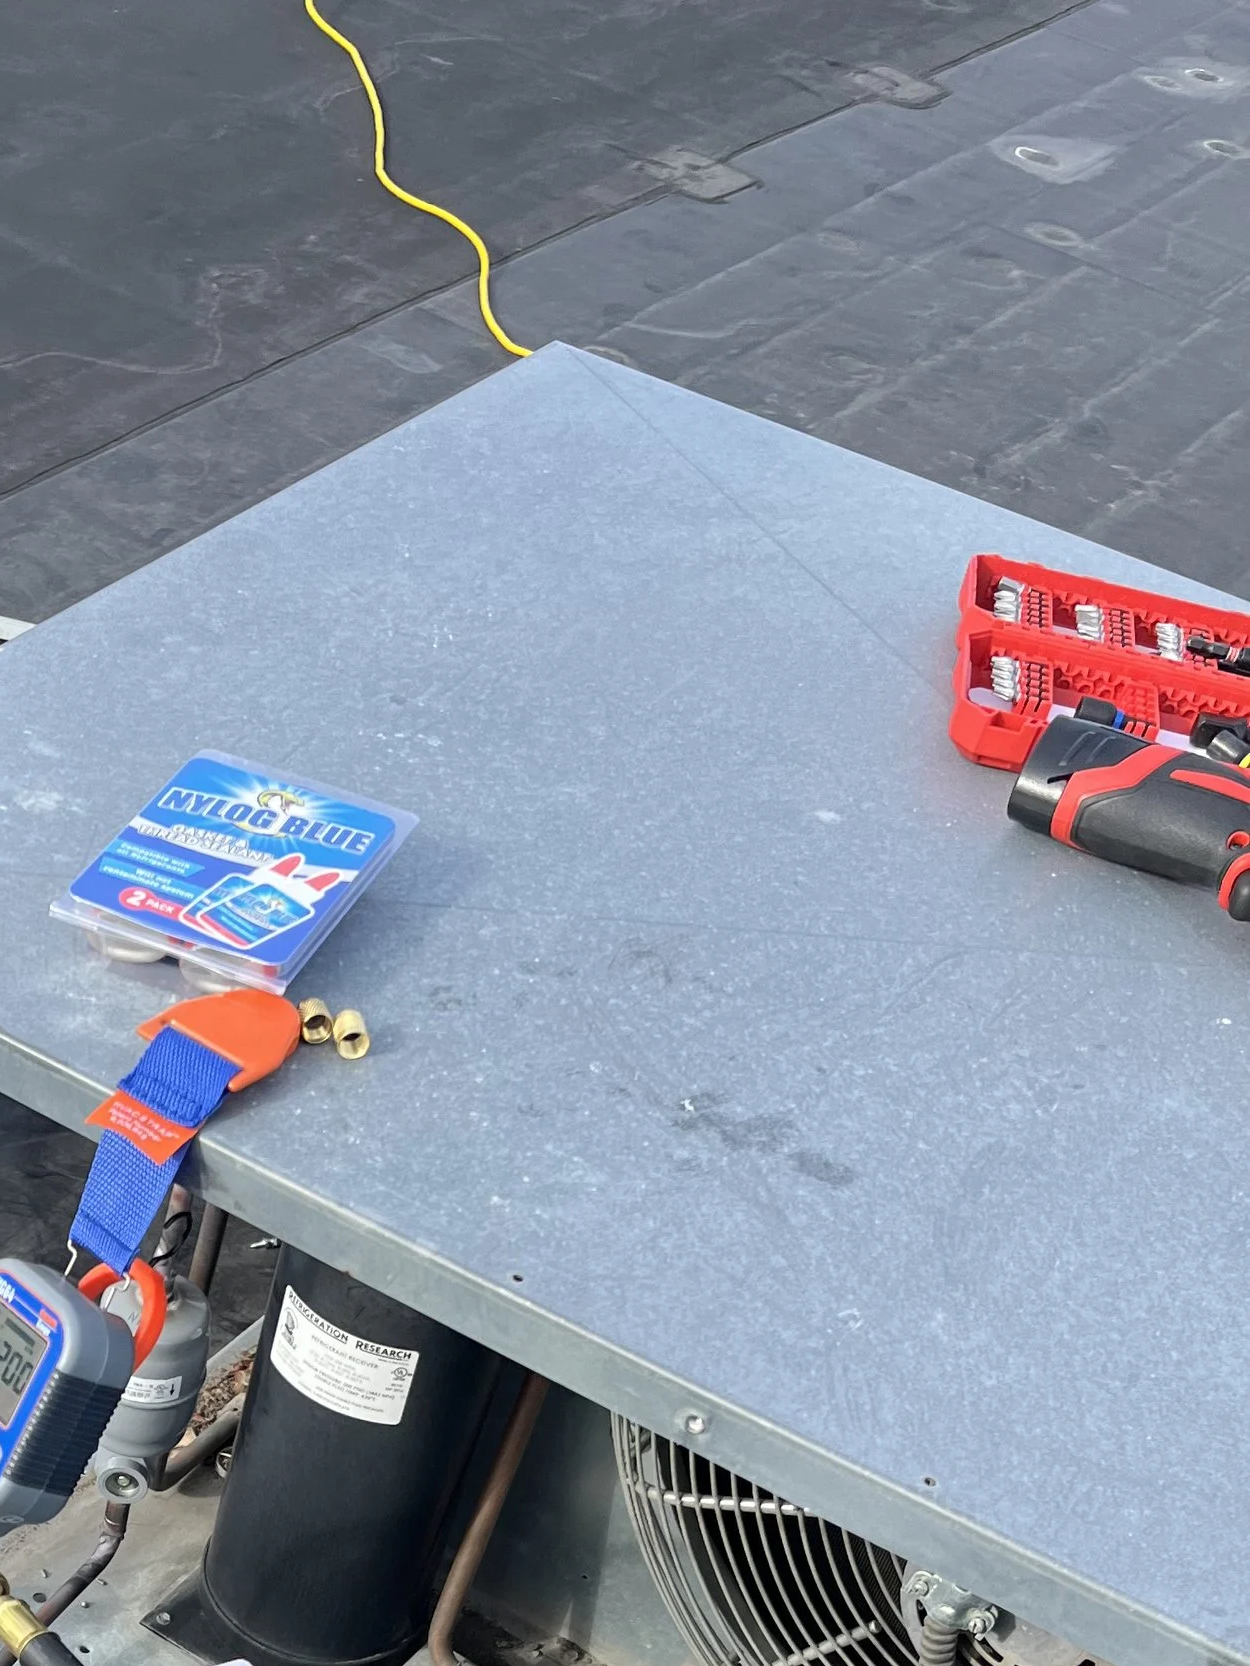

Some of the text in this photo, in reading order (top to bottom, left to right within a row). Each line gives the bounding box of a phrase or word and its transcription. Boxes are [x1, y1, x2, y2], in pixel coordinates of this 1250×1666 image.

[158, 788, 375, 855] NYLOG BLUE
[138, 824, 272, 862] THREAD SEALANT
[172, 824, 230, 844] GASKET
[103, 865, 159, 888] contaminate
[136, 868, 172, 885] Will not
[126, 891, 175, 914] 2 PACK
[356, 1340, 412, 1360] RESEARCH
